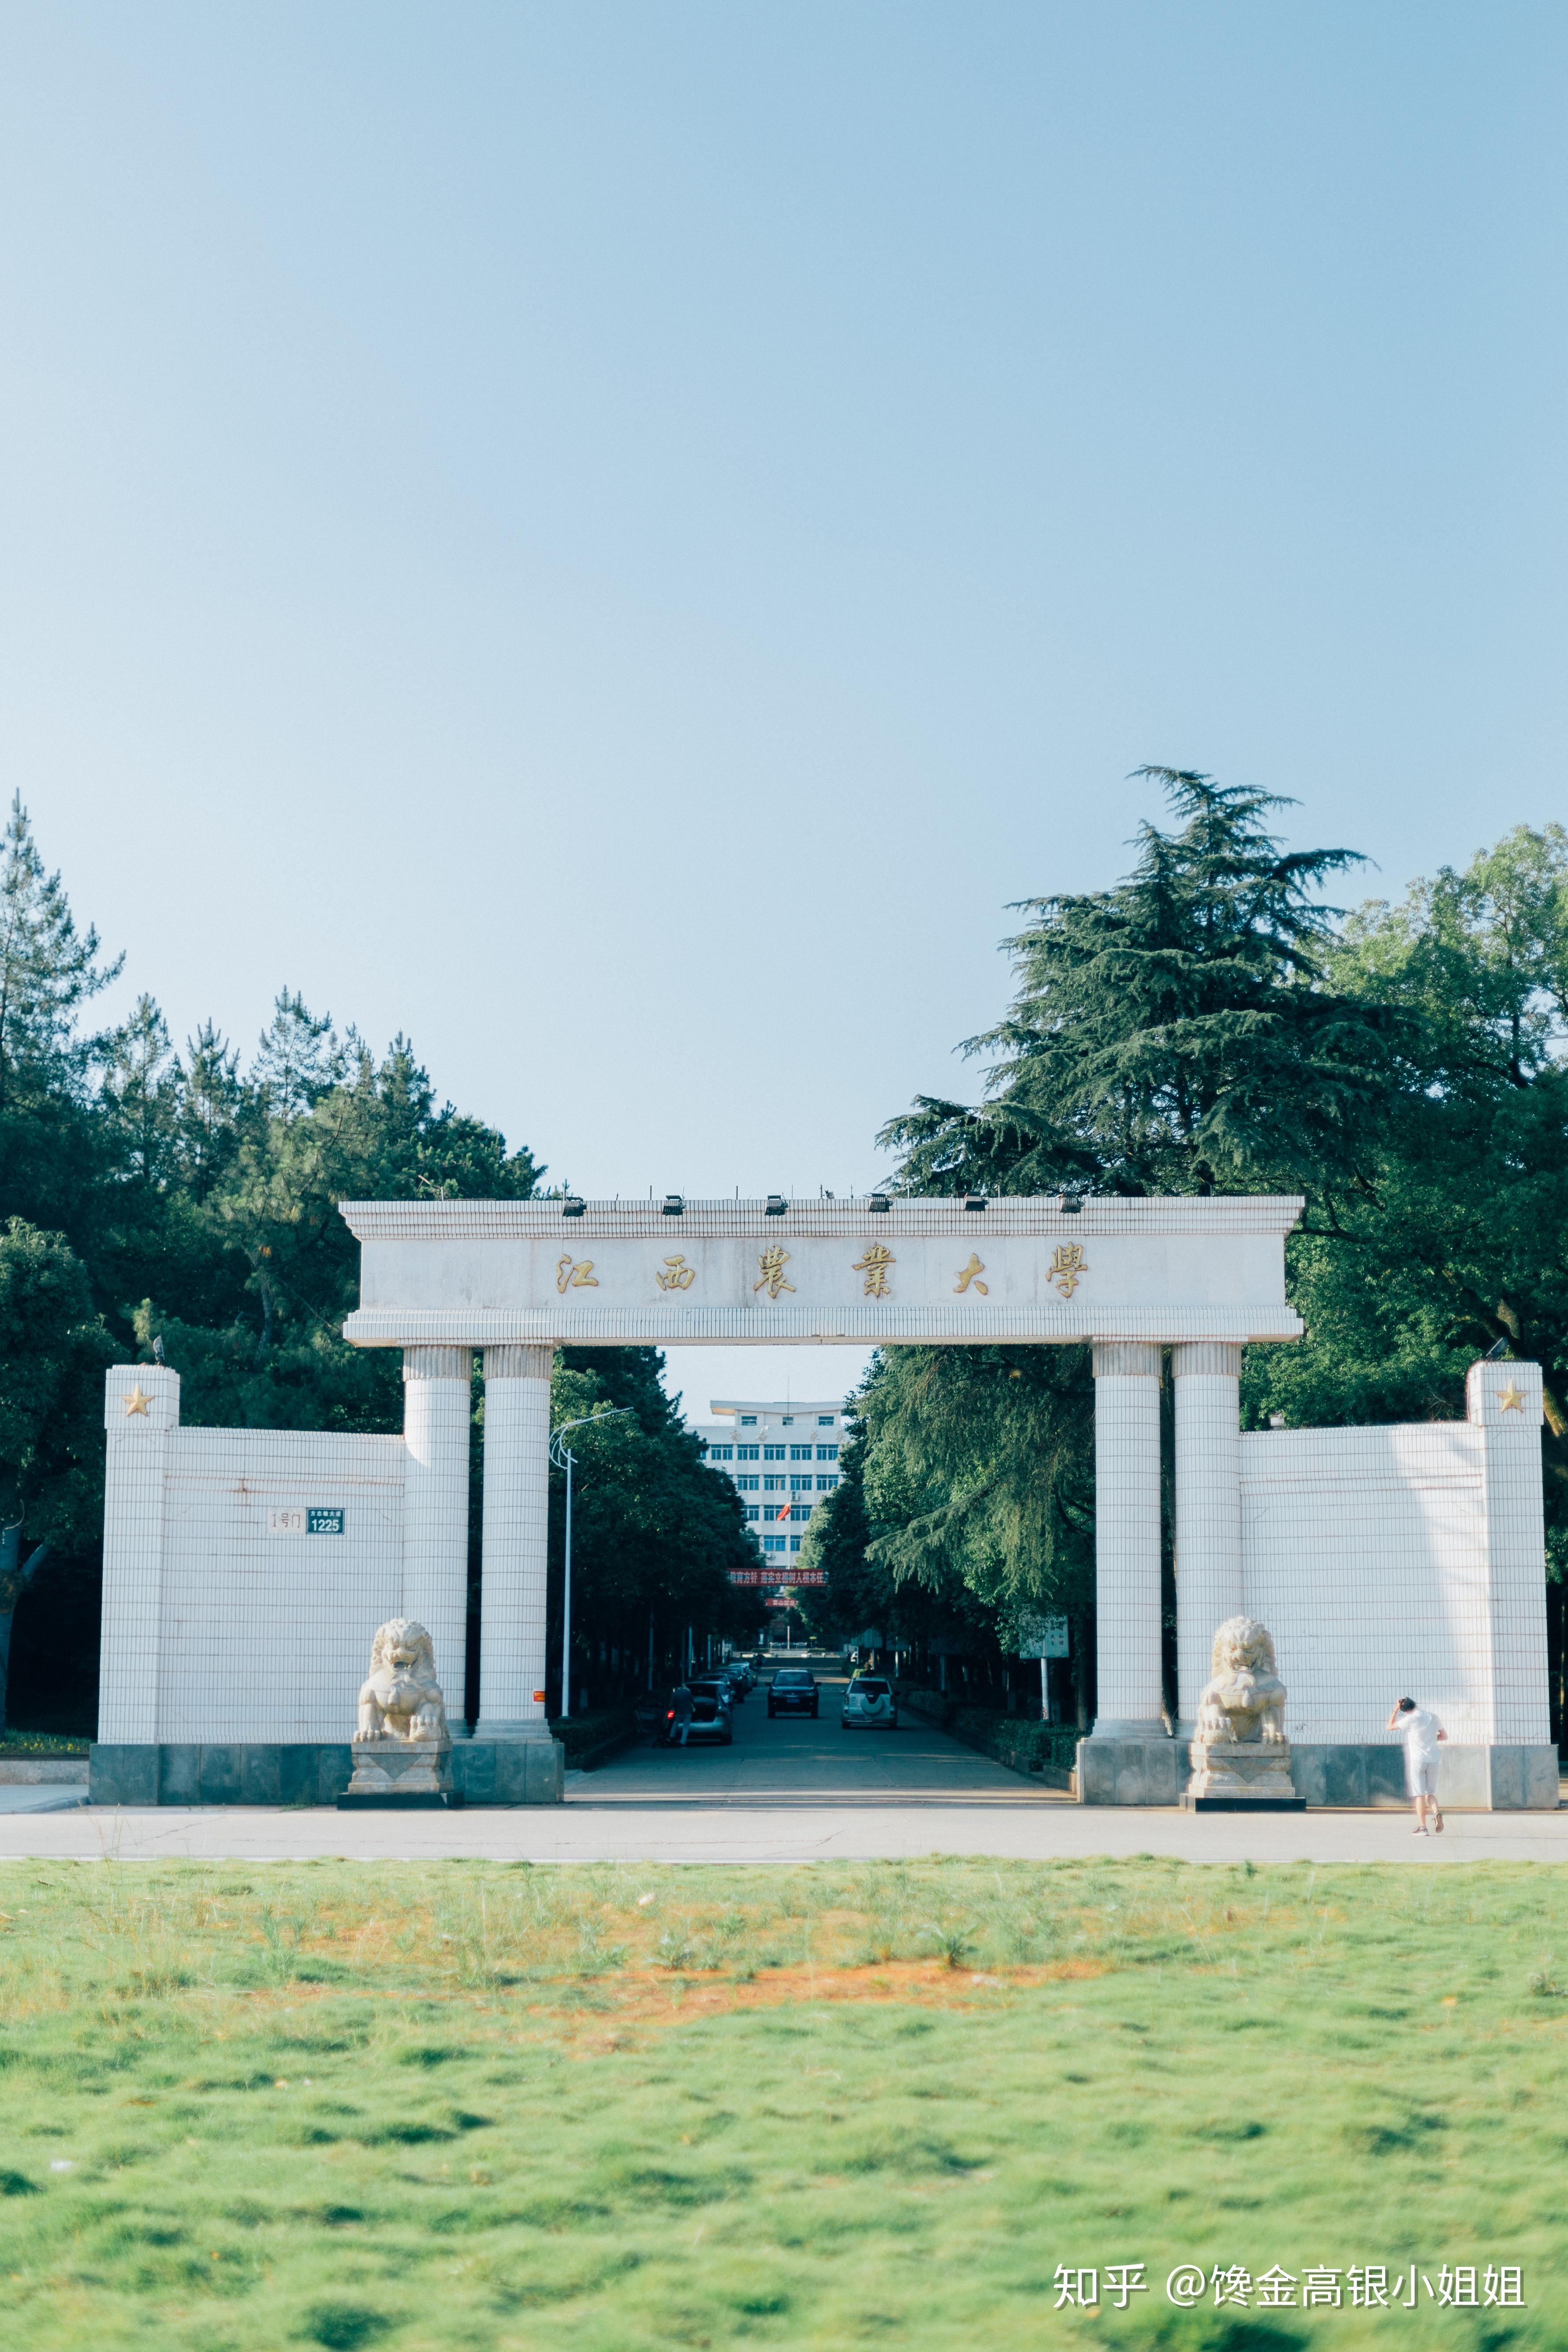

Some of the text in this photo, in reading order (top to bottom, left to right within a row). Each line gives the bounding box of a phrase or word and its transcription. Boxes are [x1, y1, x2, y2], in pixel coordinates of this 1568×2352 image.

[555, 1241, 1088, 1298] 江西農業大學
[272, 1513, 300, 1528] 1号门
[312, 1518, 339, 1532] 1225
